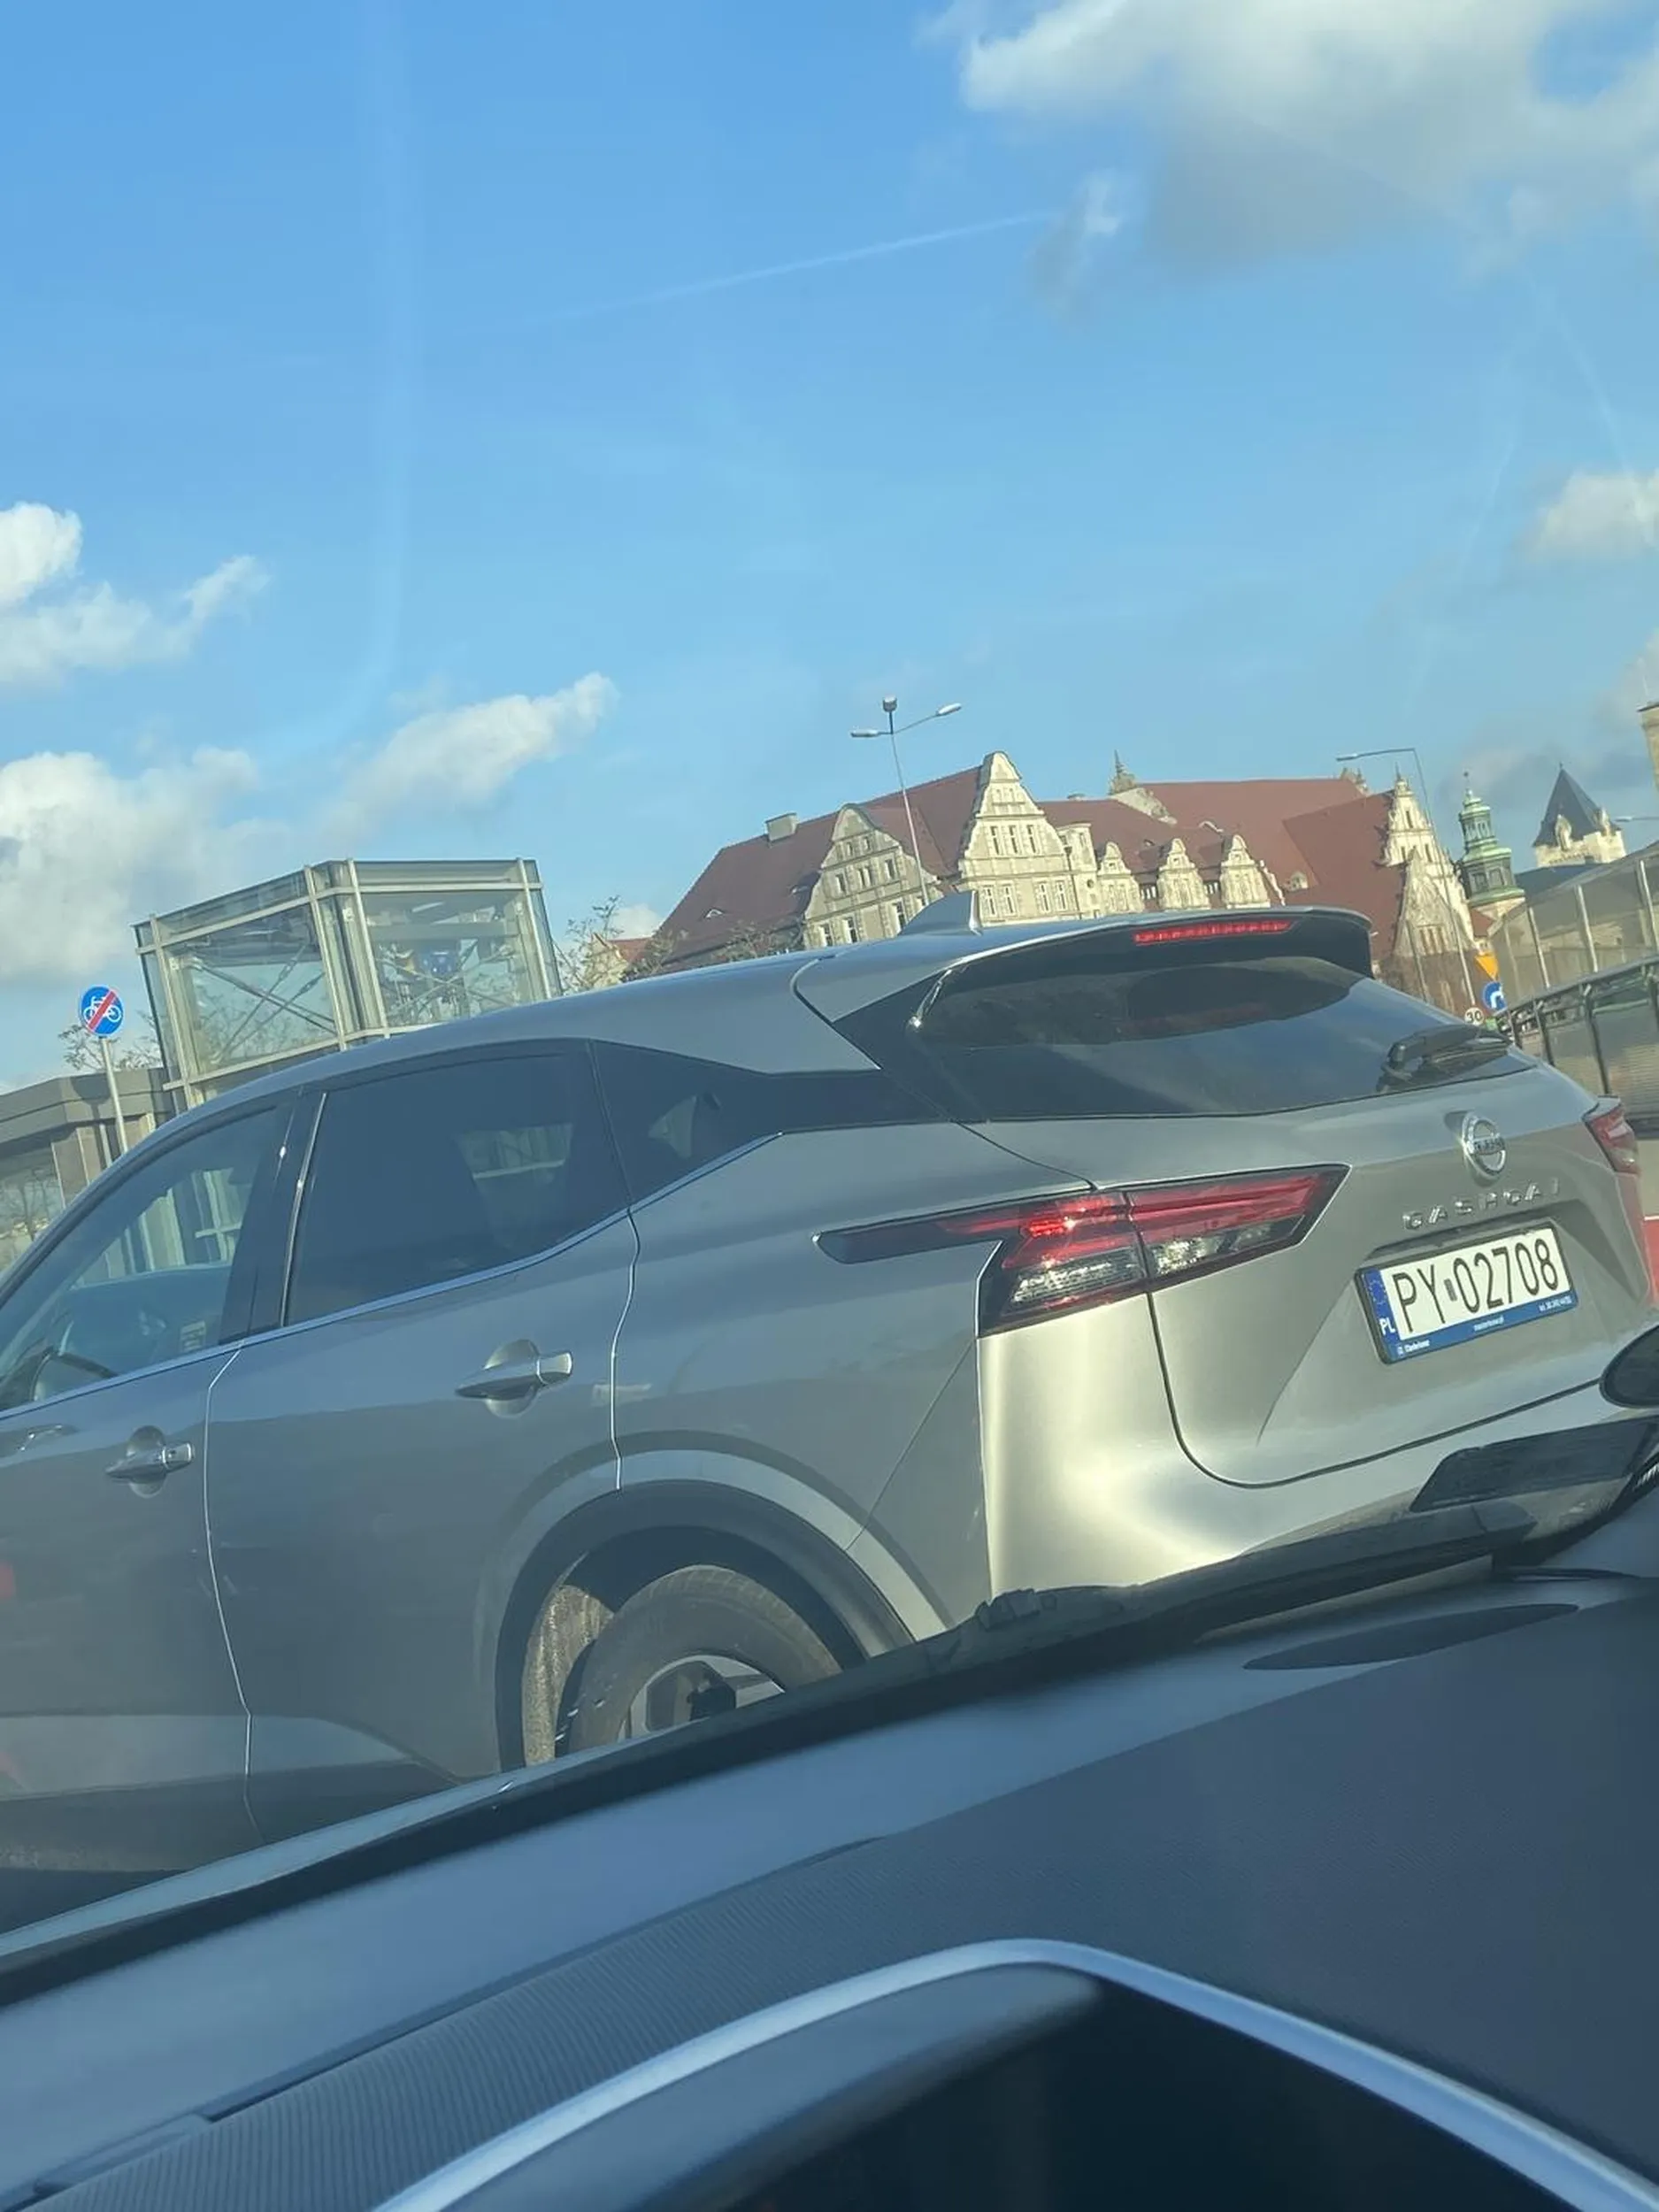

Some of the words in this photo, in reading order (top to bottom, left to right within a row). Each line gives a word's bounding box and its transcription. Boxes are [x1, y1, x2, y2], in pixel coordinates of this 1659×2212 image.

[1466, 1010, 1484, 1024] 30
[1392, 1263, 1446, 1333] PY
[1453, 1238, 1558, 1314] 02708
[1379, 1317, 1395, 1336] PL
